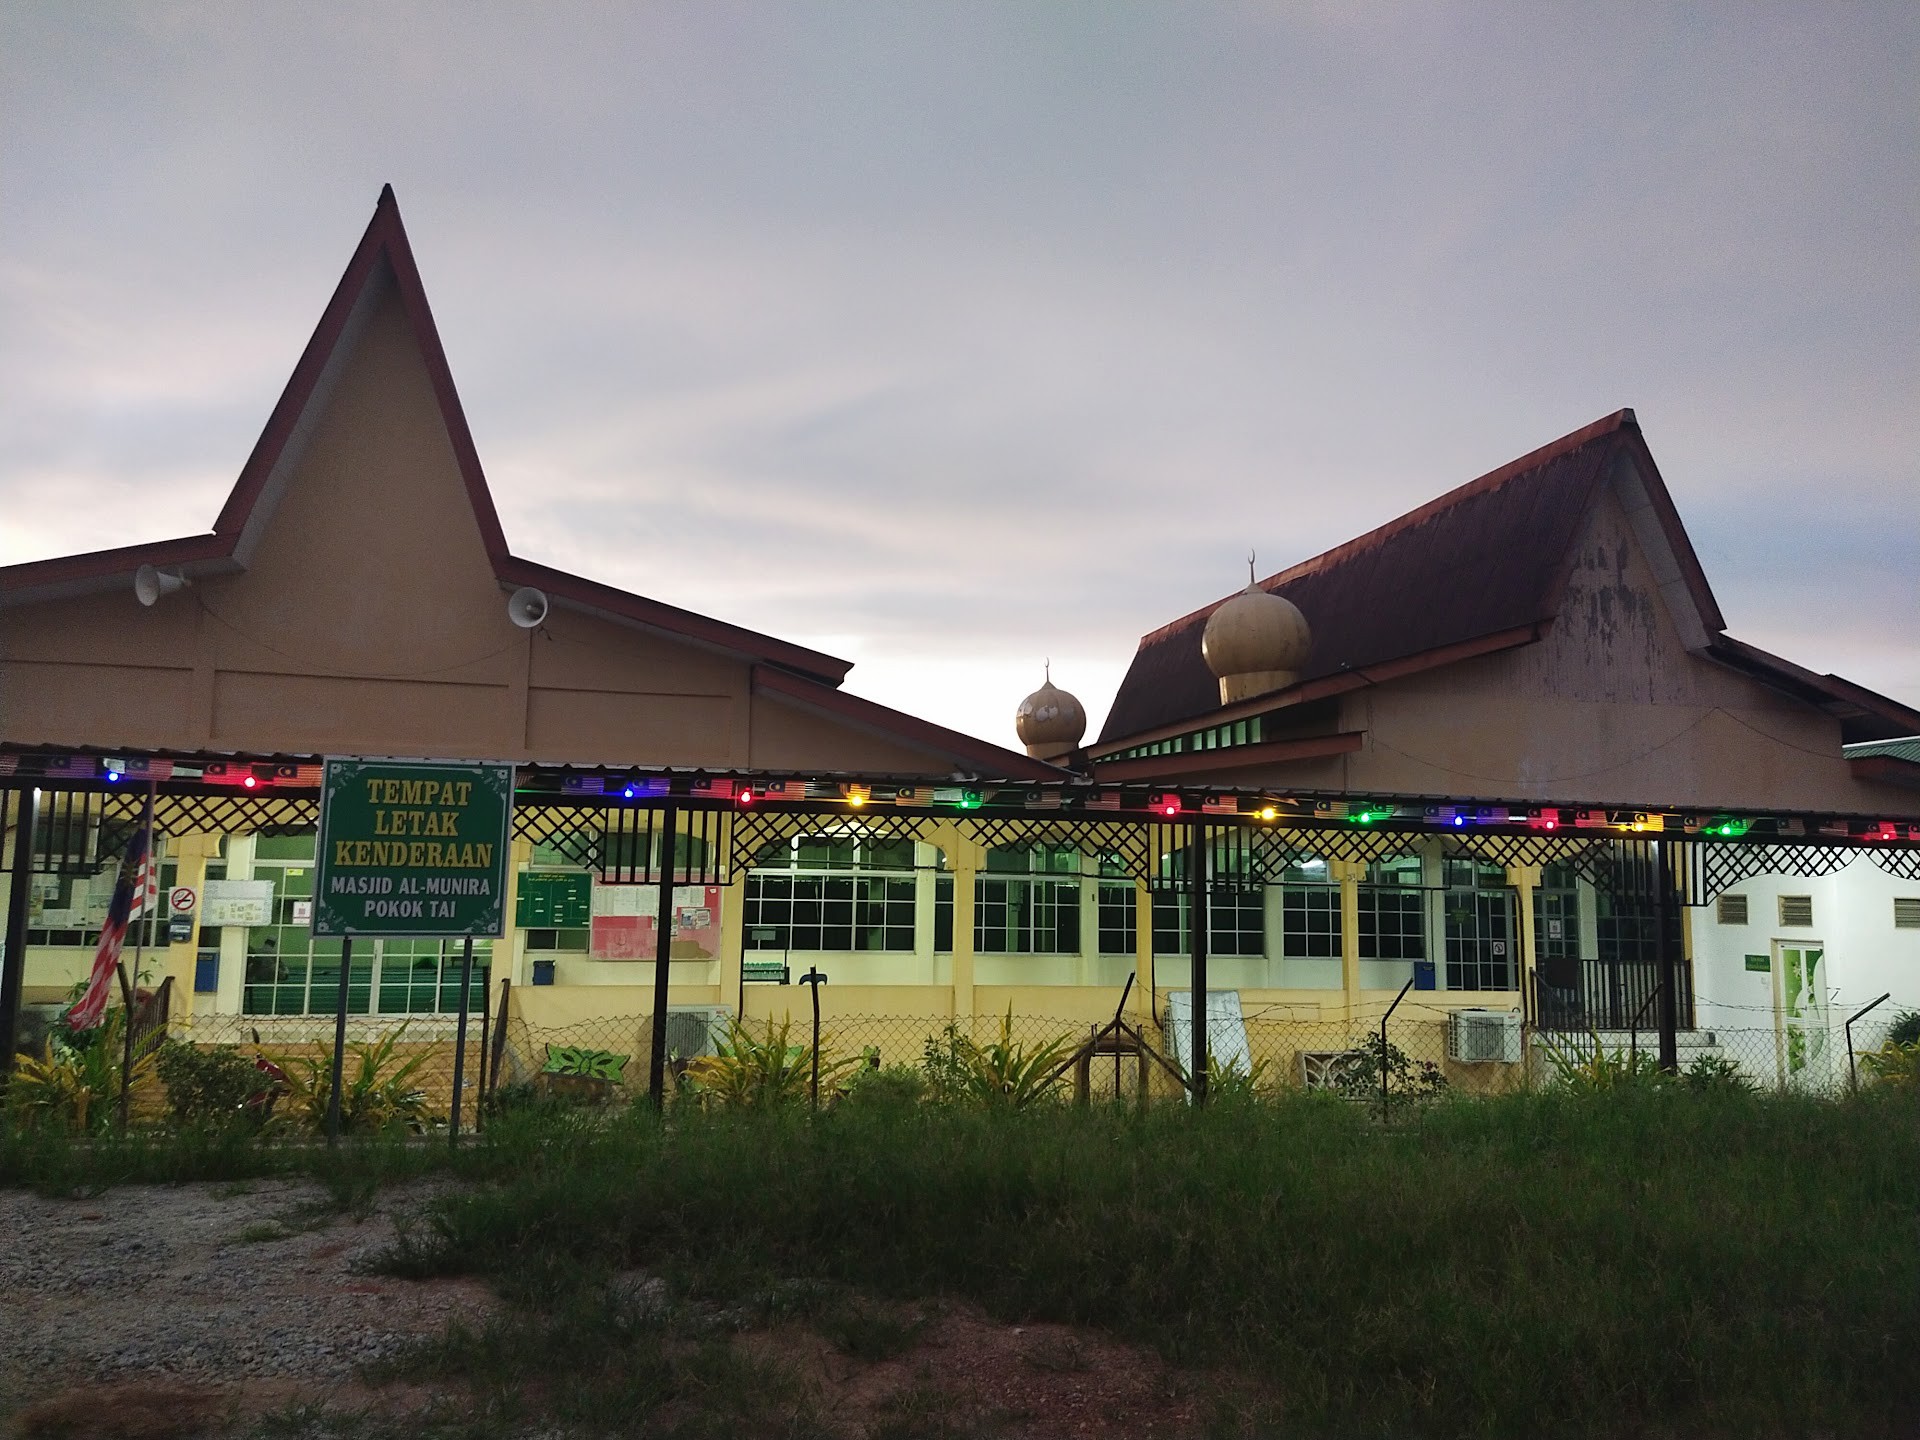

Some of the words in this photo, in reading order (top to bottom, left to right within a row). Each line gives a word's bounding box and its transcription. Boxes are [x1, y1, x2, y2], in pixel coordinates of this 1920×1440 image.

[367, 778, 472, 806] TEMPAT
[374, 810, 460, 837] LETAK
[334, 840, 493, 868] KENDERAAN
[330, 876, 393, 895] MASJID
[398, 878, 491, 896] AL-MUNIRA
[364, 900, 423, 918] POKOK
[430, 901, 456, 918] TAI
